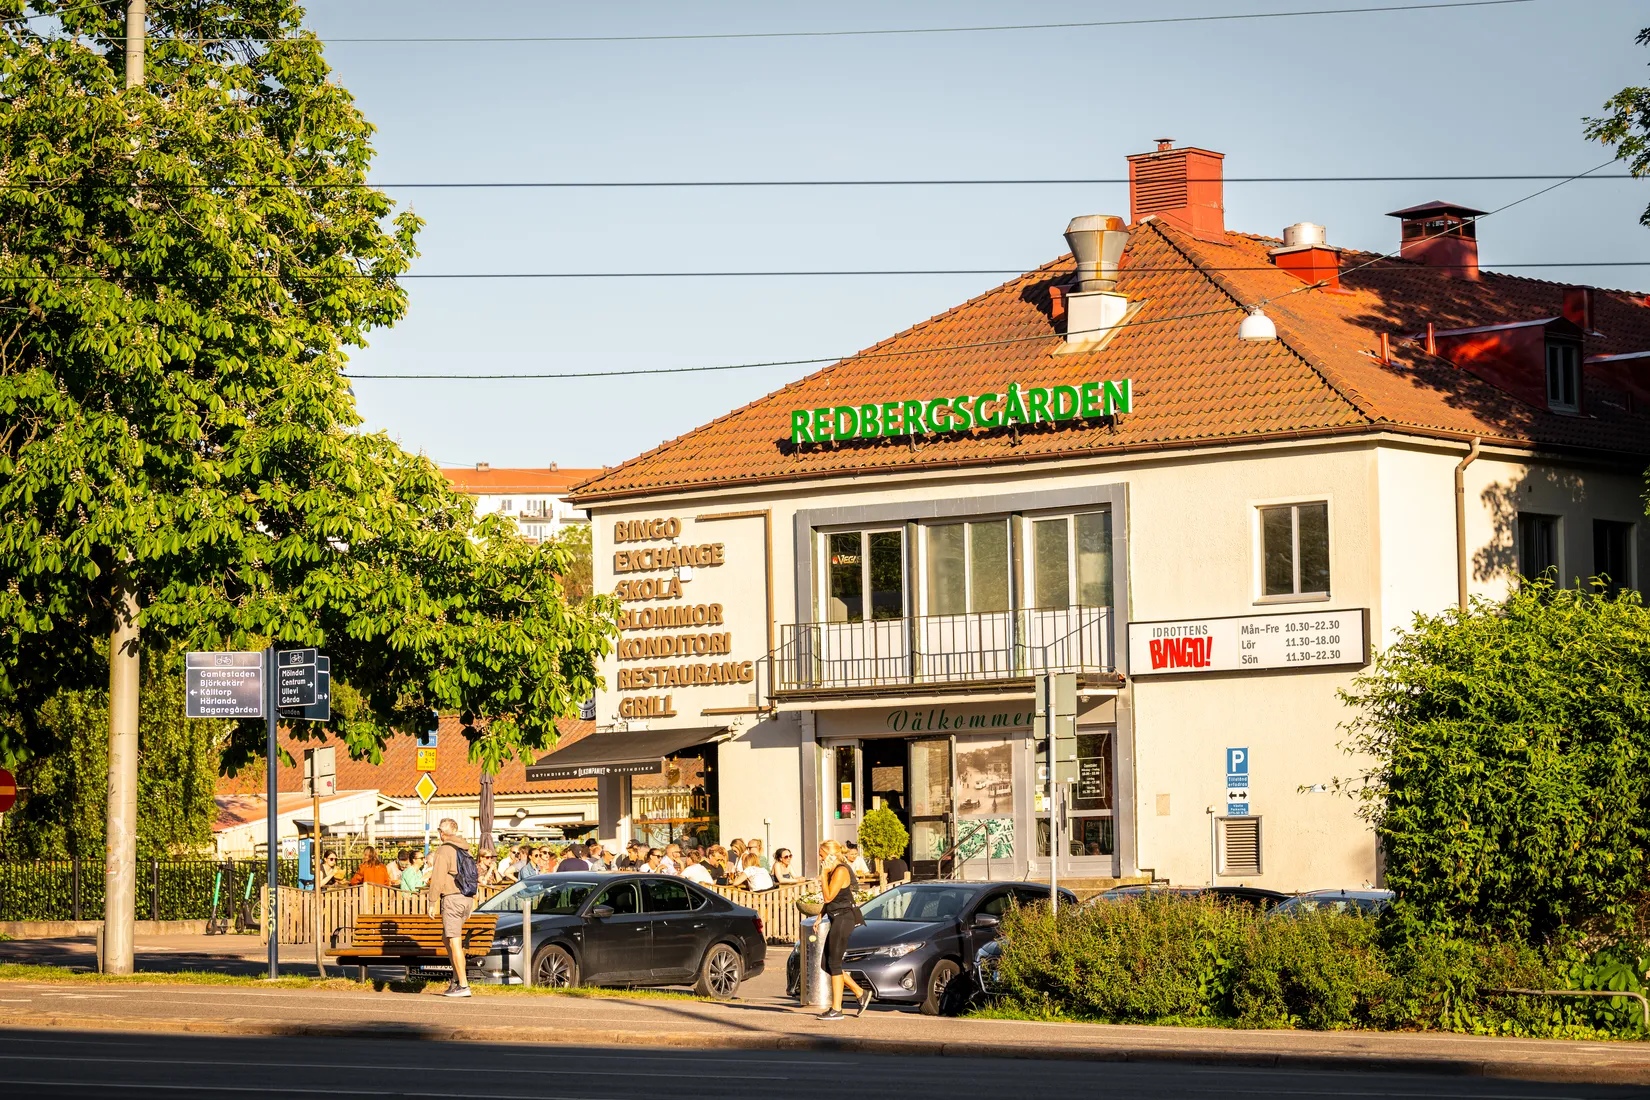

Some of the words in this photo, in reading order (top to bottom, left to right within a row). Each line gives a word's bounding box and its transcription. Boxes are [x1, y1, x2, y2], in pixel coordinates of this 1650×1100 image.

[791, 379, 1132, 444] REDBERGSGÅRDEN
[615, 517, 681, 542] BINGO
[615, 543, 725, 572] EXCHANGE
[616, 577, 683, 601] SKOLA
[617, 603, 724, 630] BLOMMOR
[1152, 625, 1208, 638] IDROTTENS
[1241, 624, 1280, 635] Mån-Fre
[1285, 620, 1340, 633] 10.30-22.30
[618, 632, 731, 660] KONDITORI
[1241, 639, 1256, 650] Lör
[1285, 635, 1340, 647] 11.30-18.00
[1149, 636, 1213, 670] BINGO!
[1241, 654, 1258, 664] Sön
[1286, 650, 1341, 662] 11.30-22.30
[200, 670, 255, 678] Gamlestaden
[282, 669, 305, 677] Mölndal
[618, 660, 754, 689] RESTAURANG
[200, 679, 244, 688] Björkekärr
[282, 687, 298, 695] Ullevi
[200, 697, 237, 705] Härlanda
[282, 696, 300, 704] Gårda
[619, 695, 677, 718] GRILL
[200, 706, 258, 714] Bagaregården
[1232, 750, 1244, 772] P
